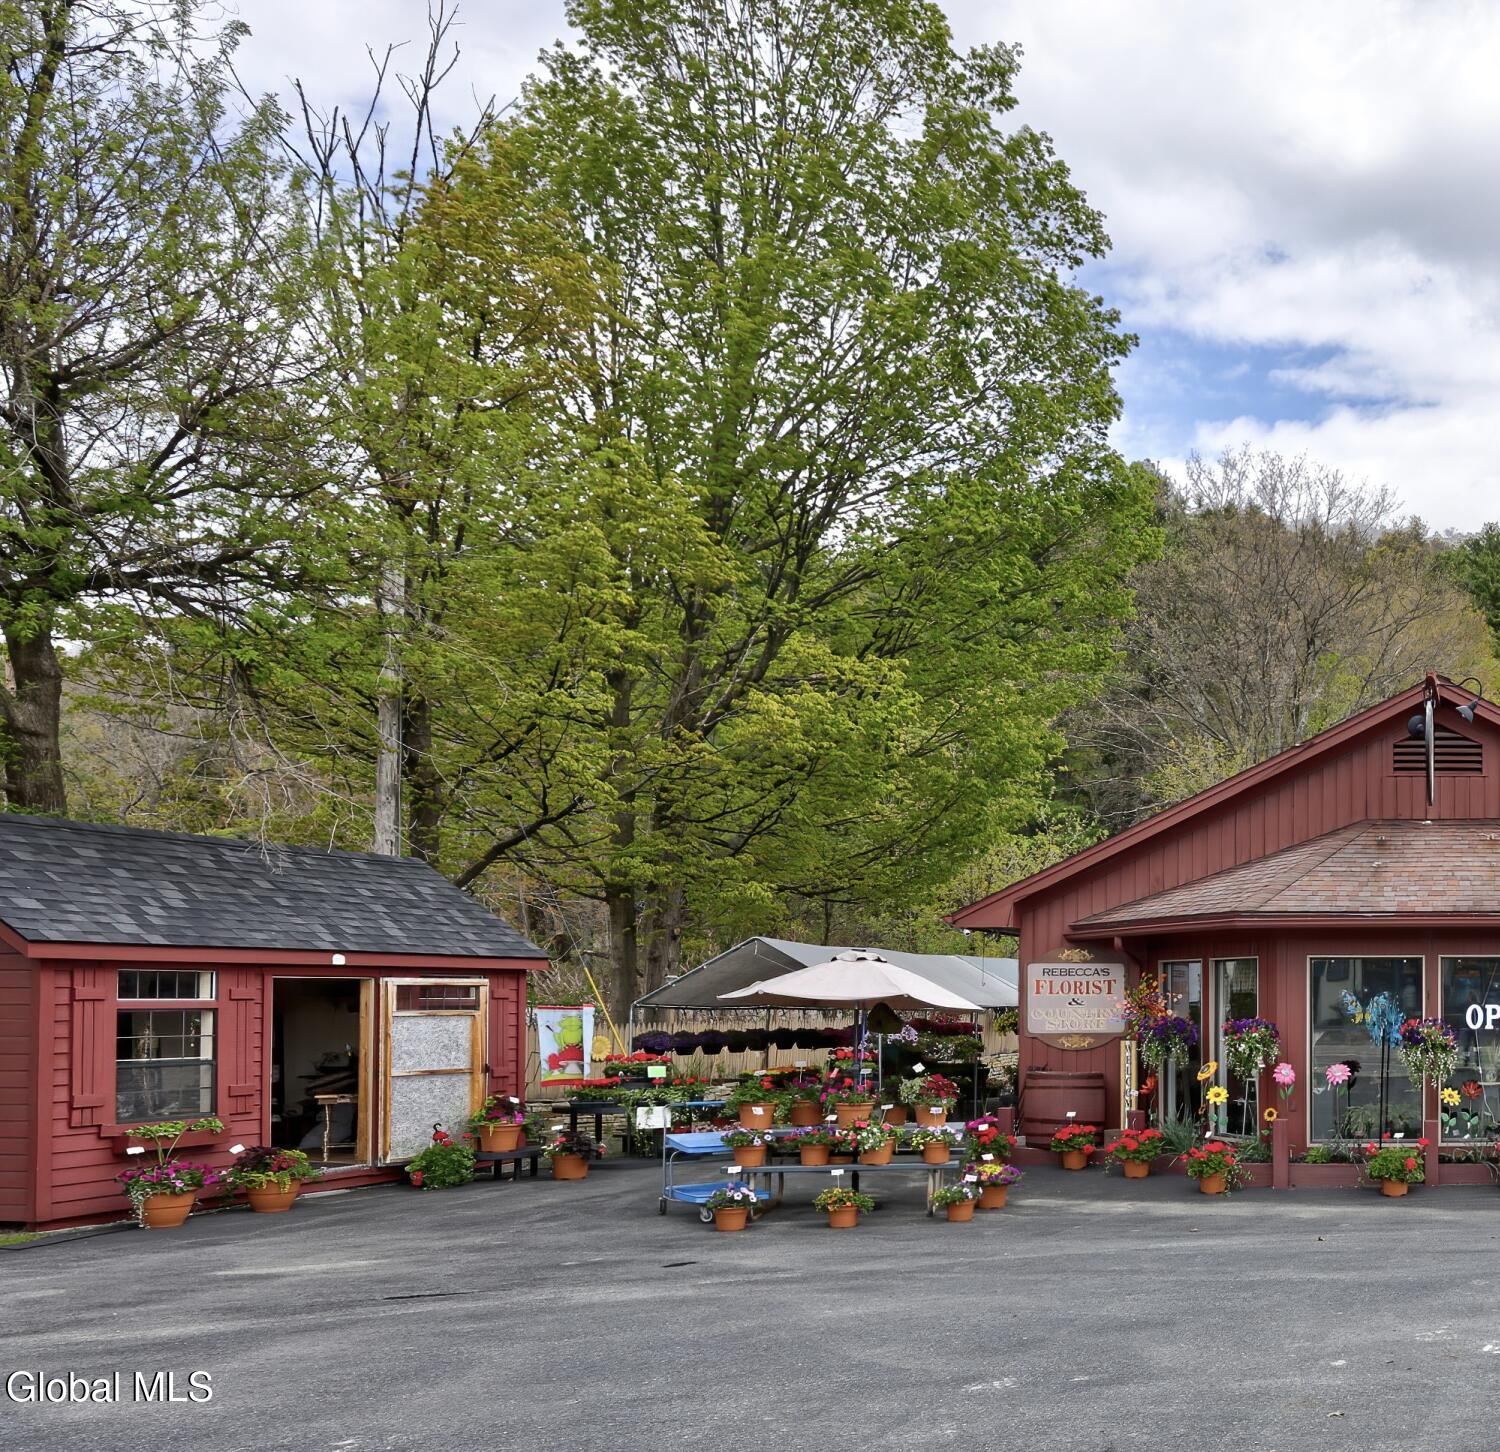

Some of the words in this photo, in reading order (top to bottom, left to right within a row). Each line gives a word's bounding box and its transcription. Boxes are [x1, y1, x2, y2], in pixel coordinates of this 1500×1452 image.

[1042, 967, 1111, 977] REBECCA'S
[1034, 979, 1117, 995] FLORIST
[1068, 997, 1084, 1006] &
[1045, 1020, 1108, 1031] STORE
